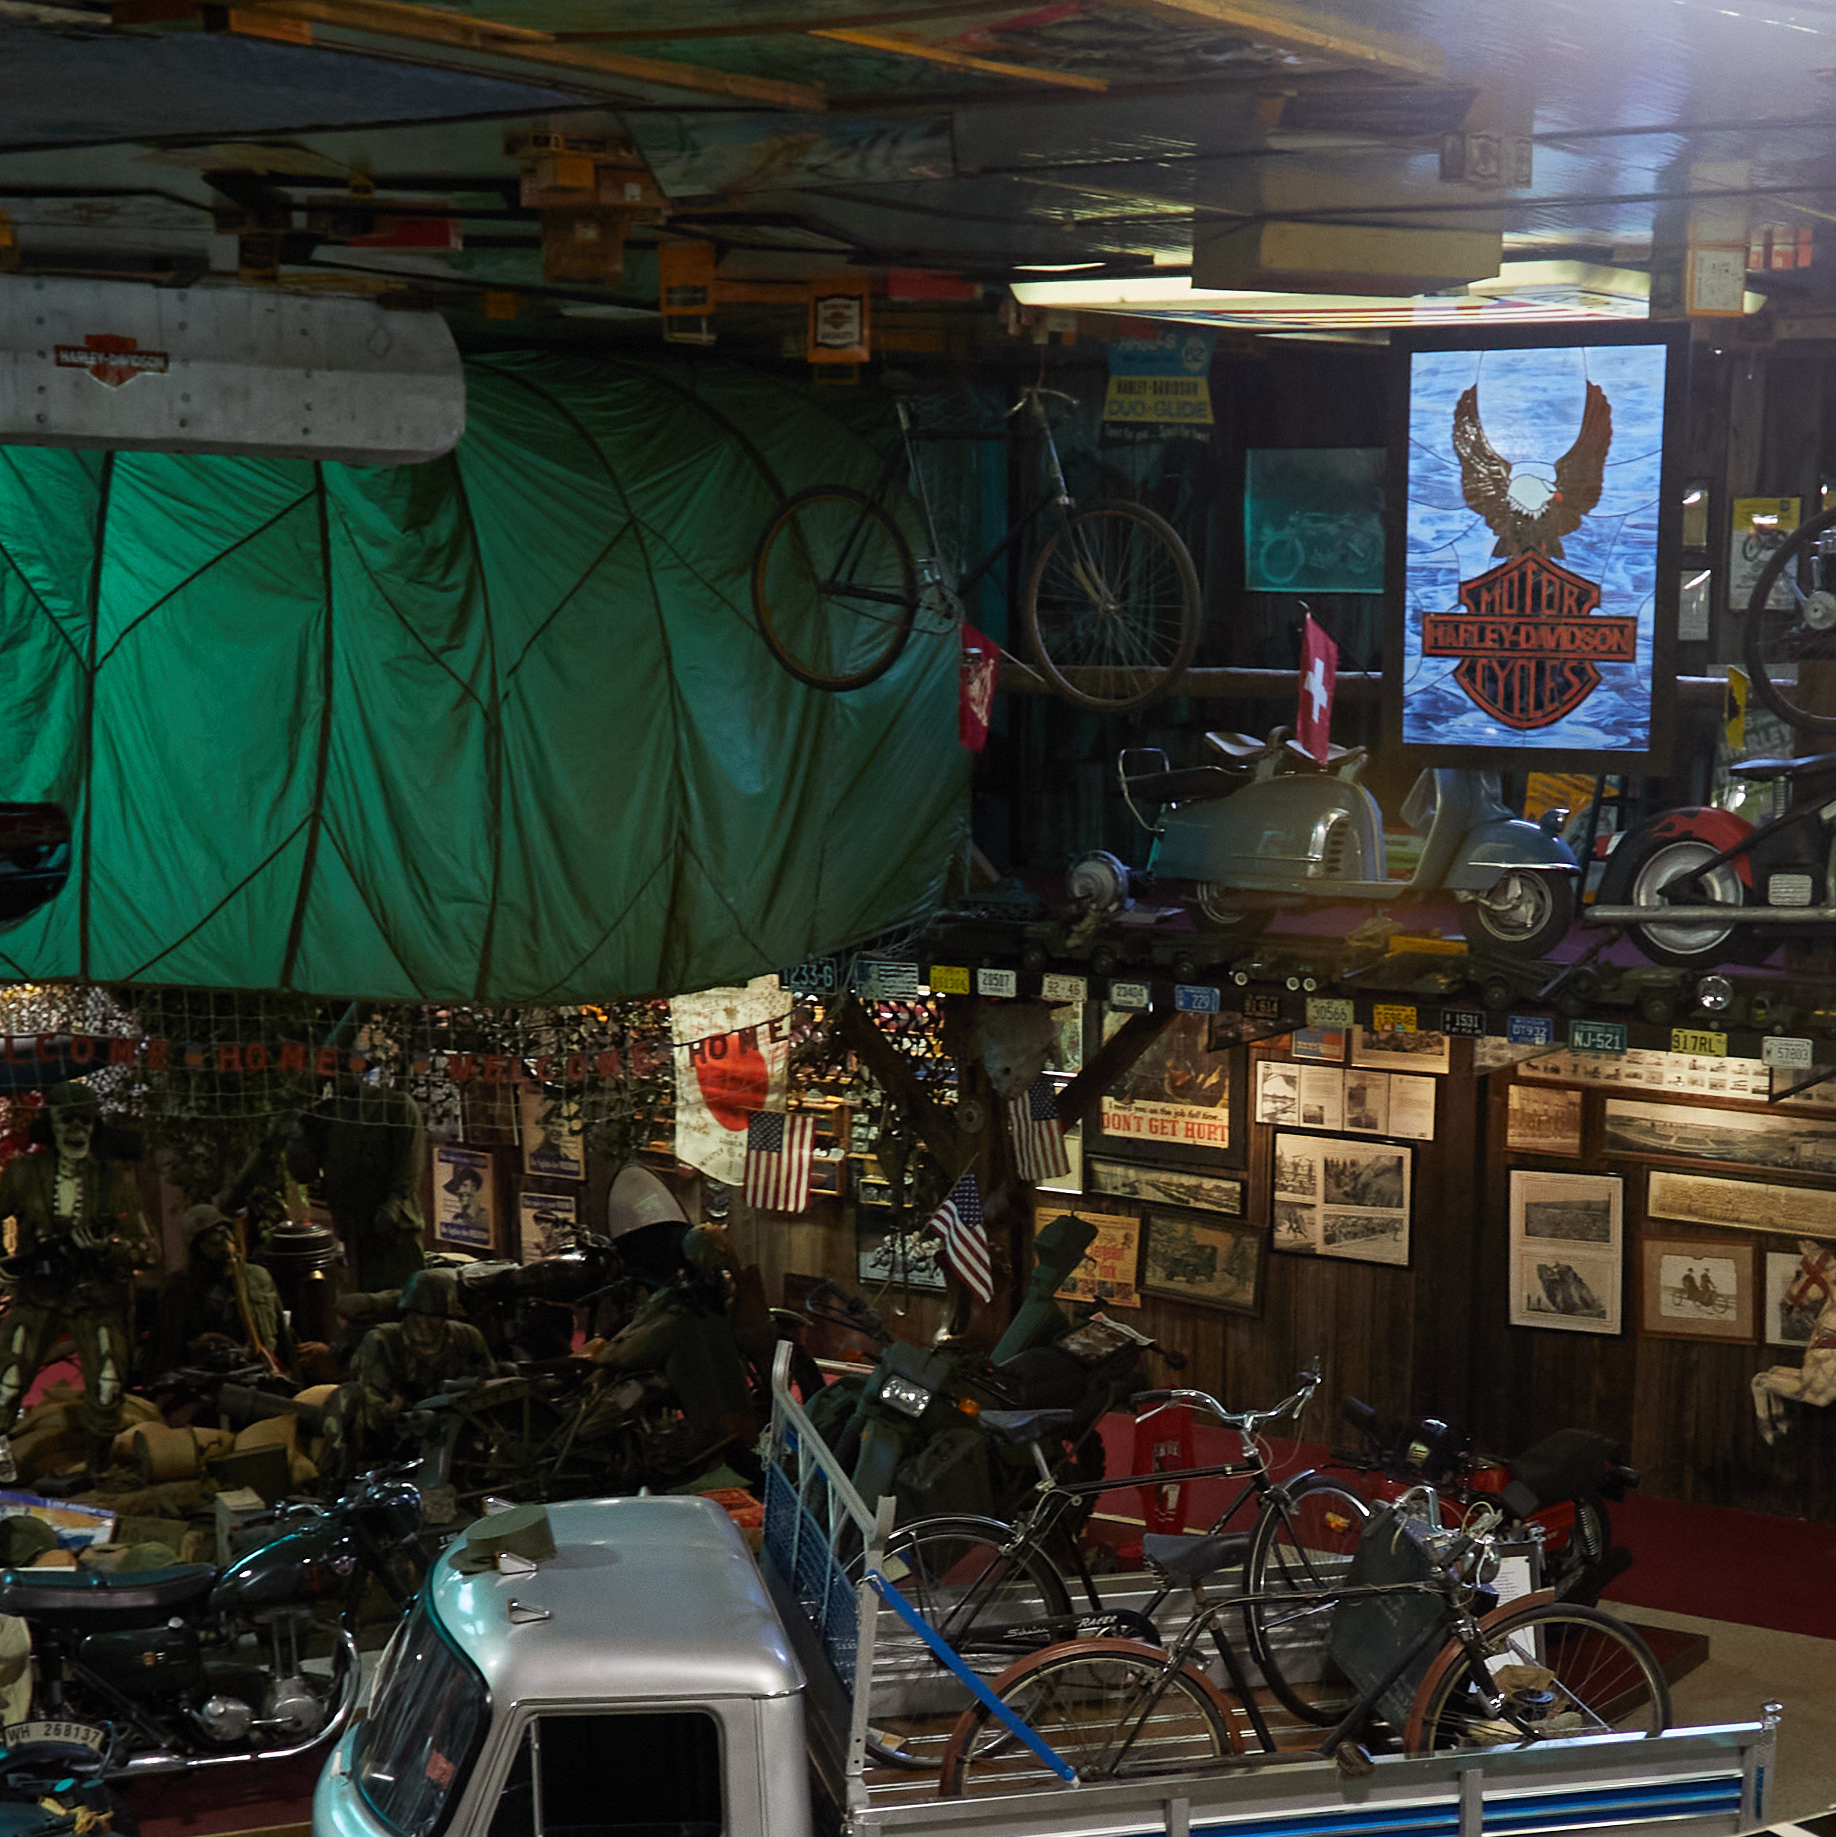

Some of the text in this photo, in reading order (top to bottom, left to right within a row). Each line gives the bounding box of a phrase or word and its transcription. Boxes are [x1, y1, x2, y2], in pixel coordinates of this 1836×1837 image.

[1106, 400, 1208, 419] DUO-GLIDE
[1479, 562, 1581, 616] MOTOR
[1429, 619, 1630, 653] HARLEY-DAVIDSON
[1475, 658, 1582, 719] CYCLES
[688, 1018, 789, 1068] HOME
[1574, 1031, 1621, 1050] NJ-521
[215, 1042, 340, 1079] HOME
[1100, 1111, 1230, 1143] DON'T GET HURT
[7, 1722, 101, 1744] WH 268137
